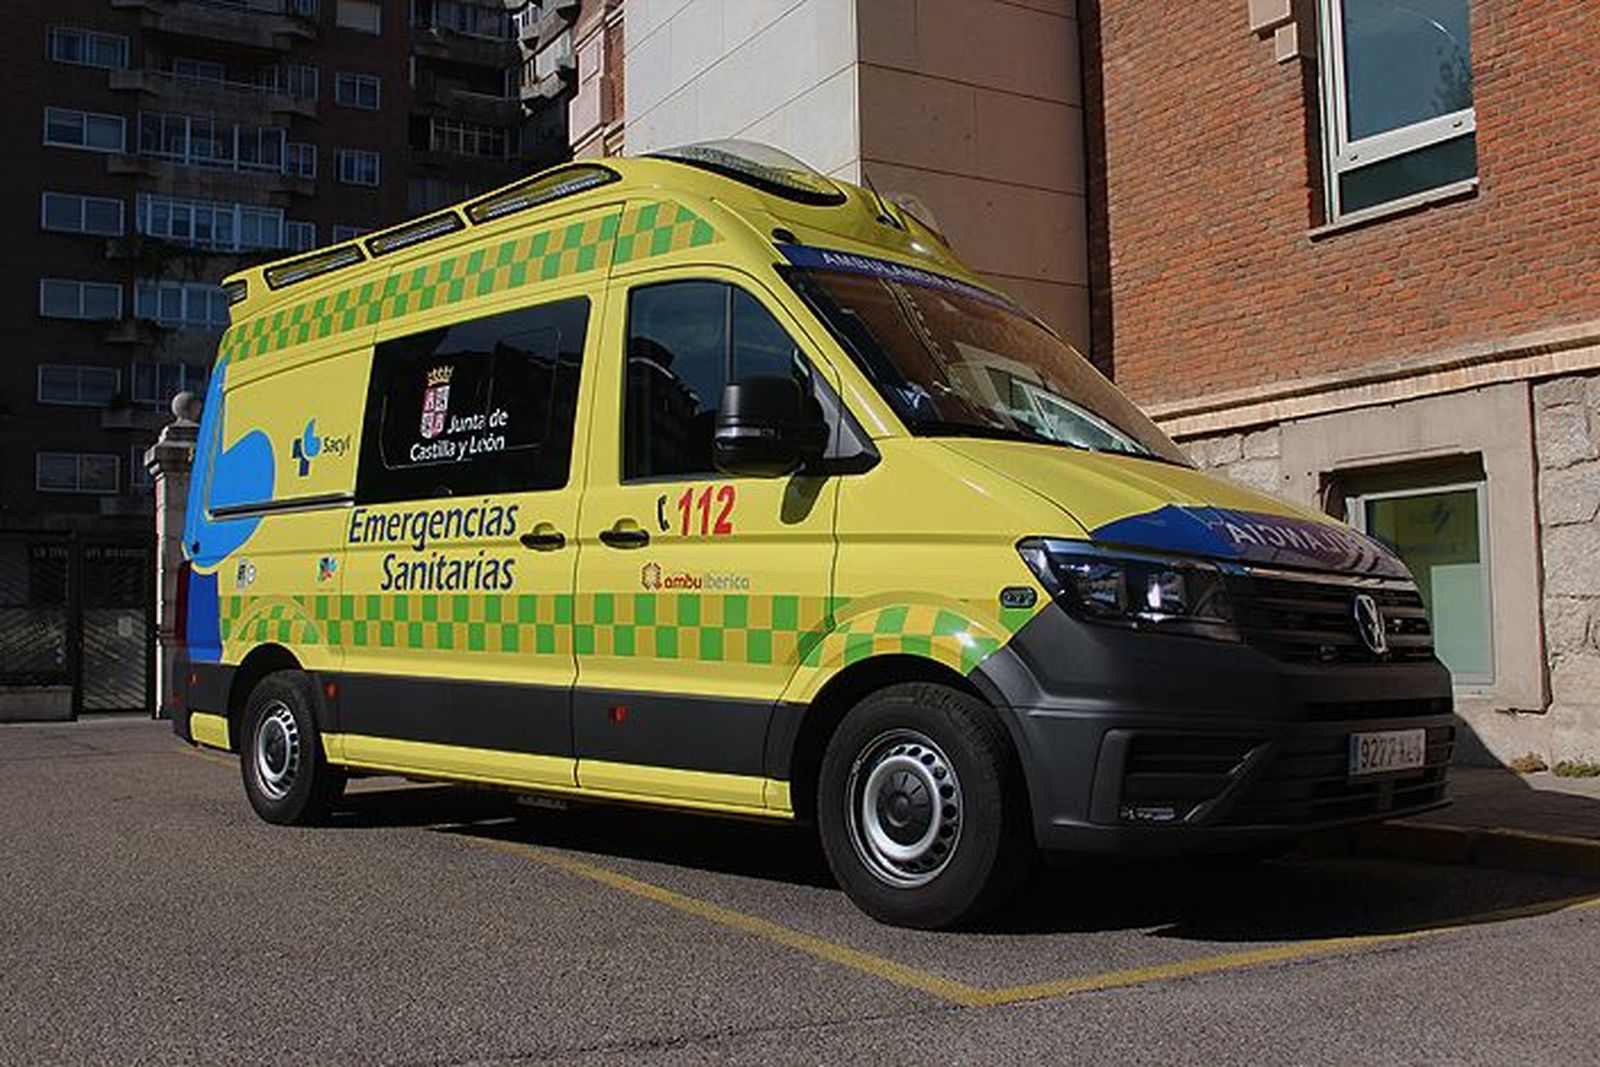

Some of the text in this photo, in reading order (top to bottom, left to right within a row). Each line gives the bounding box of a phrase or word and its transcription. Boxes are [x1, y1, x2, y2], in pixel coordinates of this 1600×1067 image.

[446, 408, 509, 434] Junta de
[322, 434, 351, 457] Sacyl
[410, 433, 505, 461] Castilla y León
[348, 500, 519, 552] Emergencias
[677, 485, 736, 536] 112
[380, 550, 516, 592] Sanitarias
